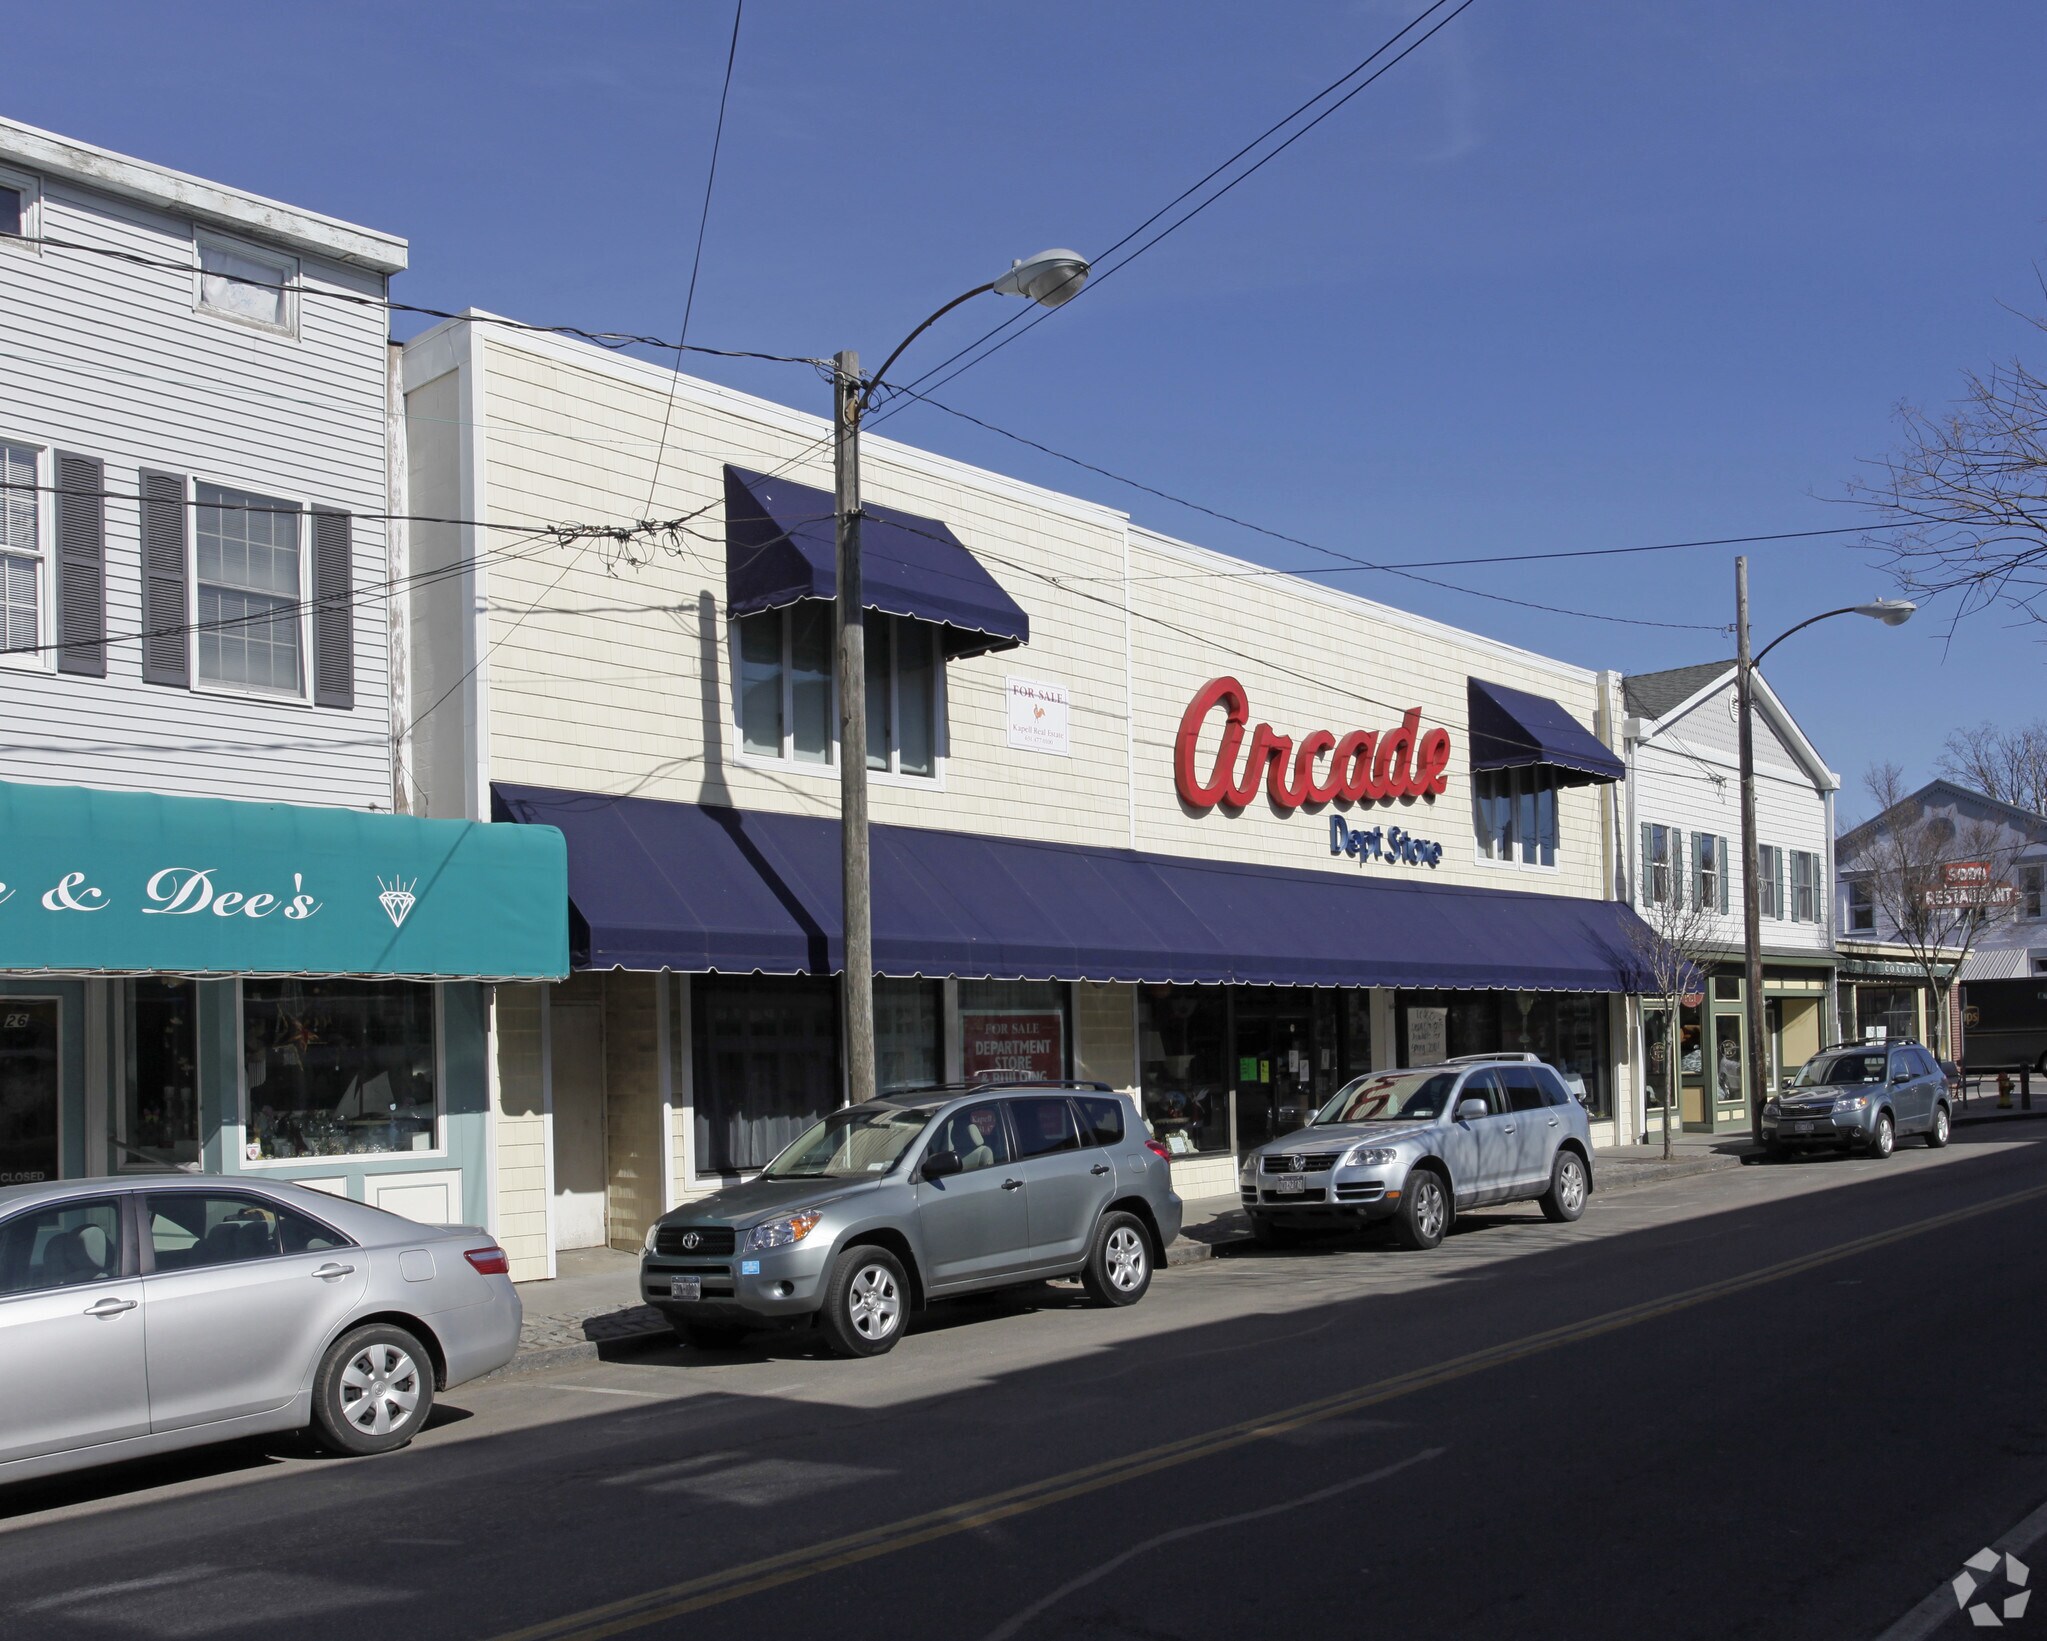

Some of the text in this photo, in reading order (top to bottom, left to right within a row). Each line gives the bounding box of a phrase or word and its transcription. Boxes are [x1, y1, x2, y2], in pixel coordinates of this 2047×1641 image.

[1013, 684, 1063, 704] FOR SALE
[1012, 724, 1065, 739] Kapell Real Estate
[1174, 675, 1451, 808] Arcade
[1329, 814, 1443, 866] Dept Store
[42, 872, 111, 911] &
[141, 867, 324, 920] Dee's
[1925, 887, 2013, 905] RESTAURANT
[6, 1014, 28, 1027] 26
[985, 1022, 1039, 1035] FOR SALE
[975, 1040, 1052, 1056] DEPARTMENT
[994, 1055, 1032, 1070] STORE
[0, 1171, 46, 1183] CLOSED
